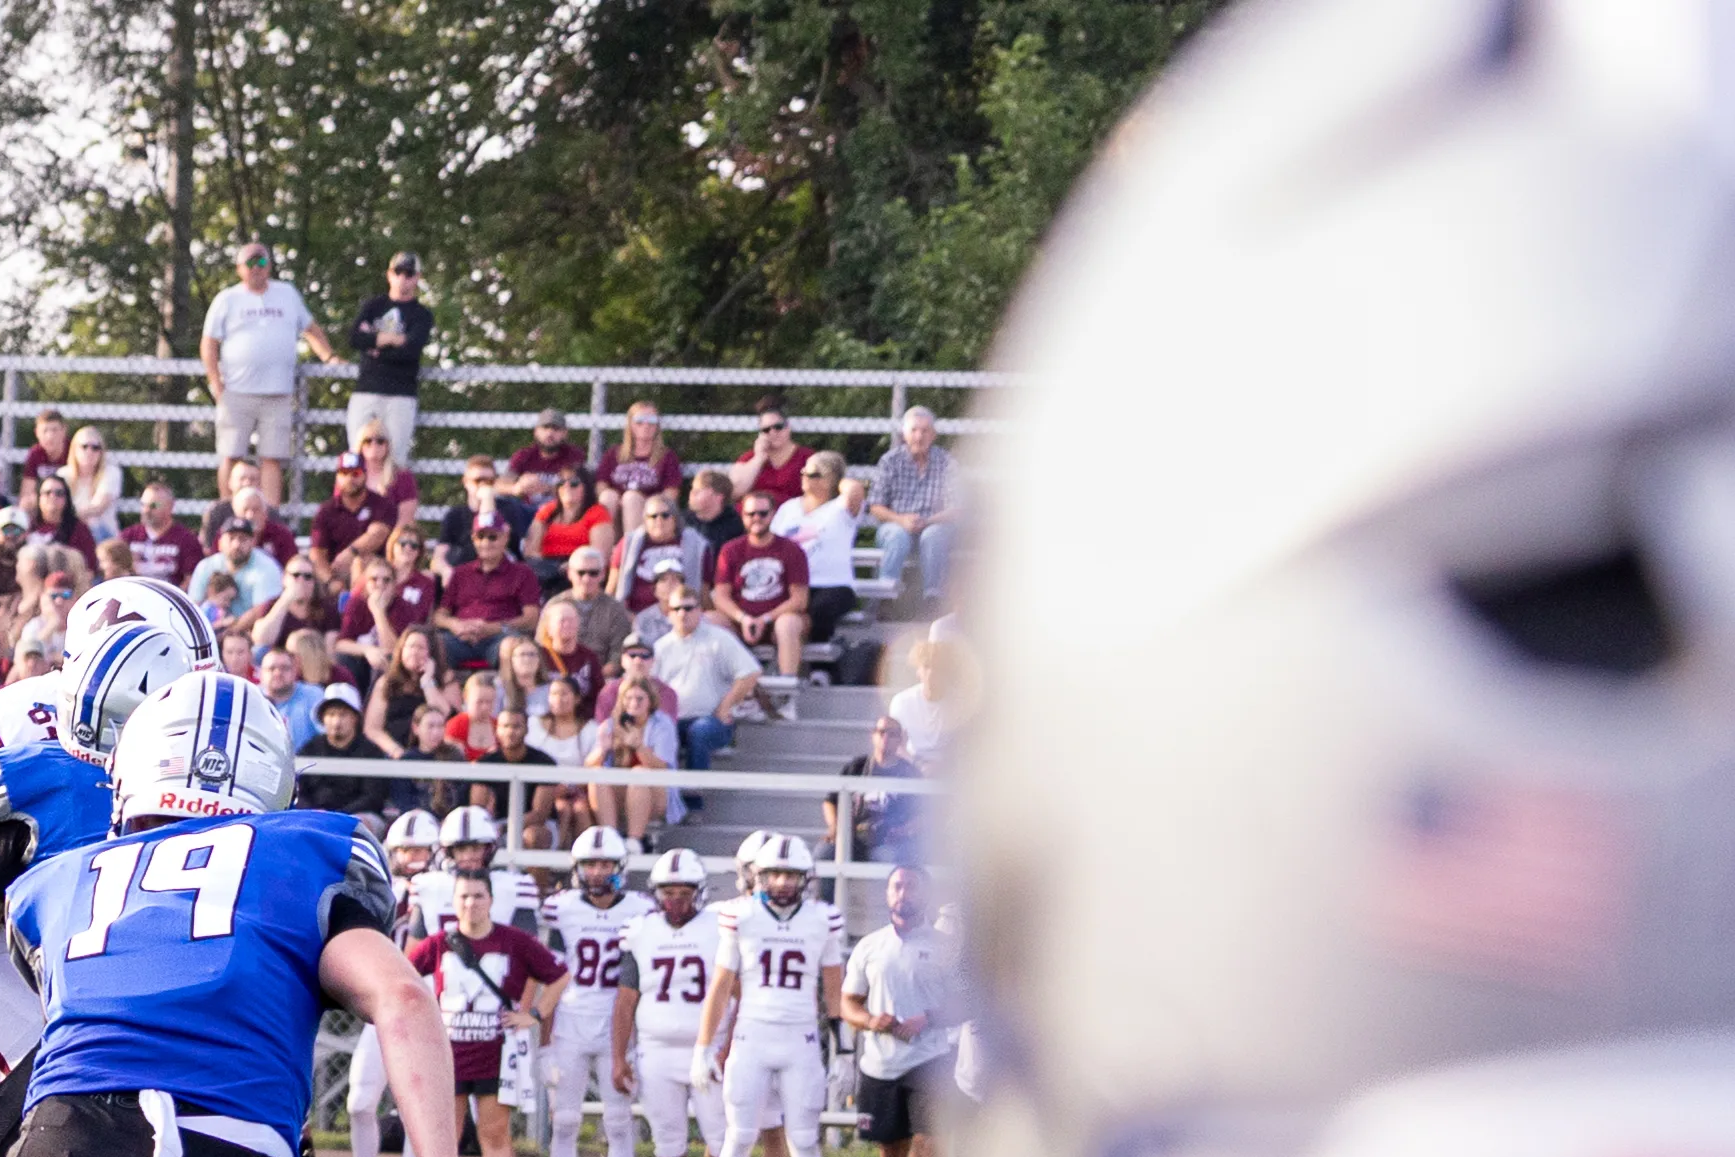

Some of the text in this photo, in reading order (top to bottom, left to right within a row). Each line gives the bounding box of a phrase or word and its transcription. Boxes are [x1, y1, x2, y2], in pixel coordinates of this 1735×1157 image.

[200, 757, 225, 772] NIC
[65, 823, 257, 963] 19
[576, 938, 621, 988] 82
[652, 955, 706, 1003] 73
[758, 949, 806, 990] 16
